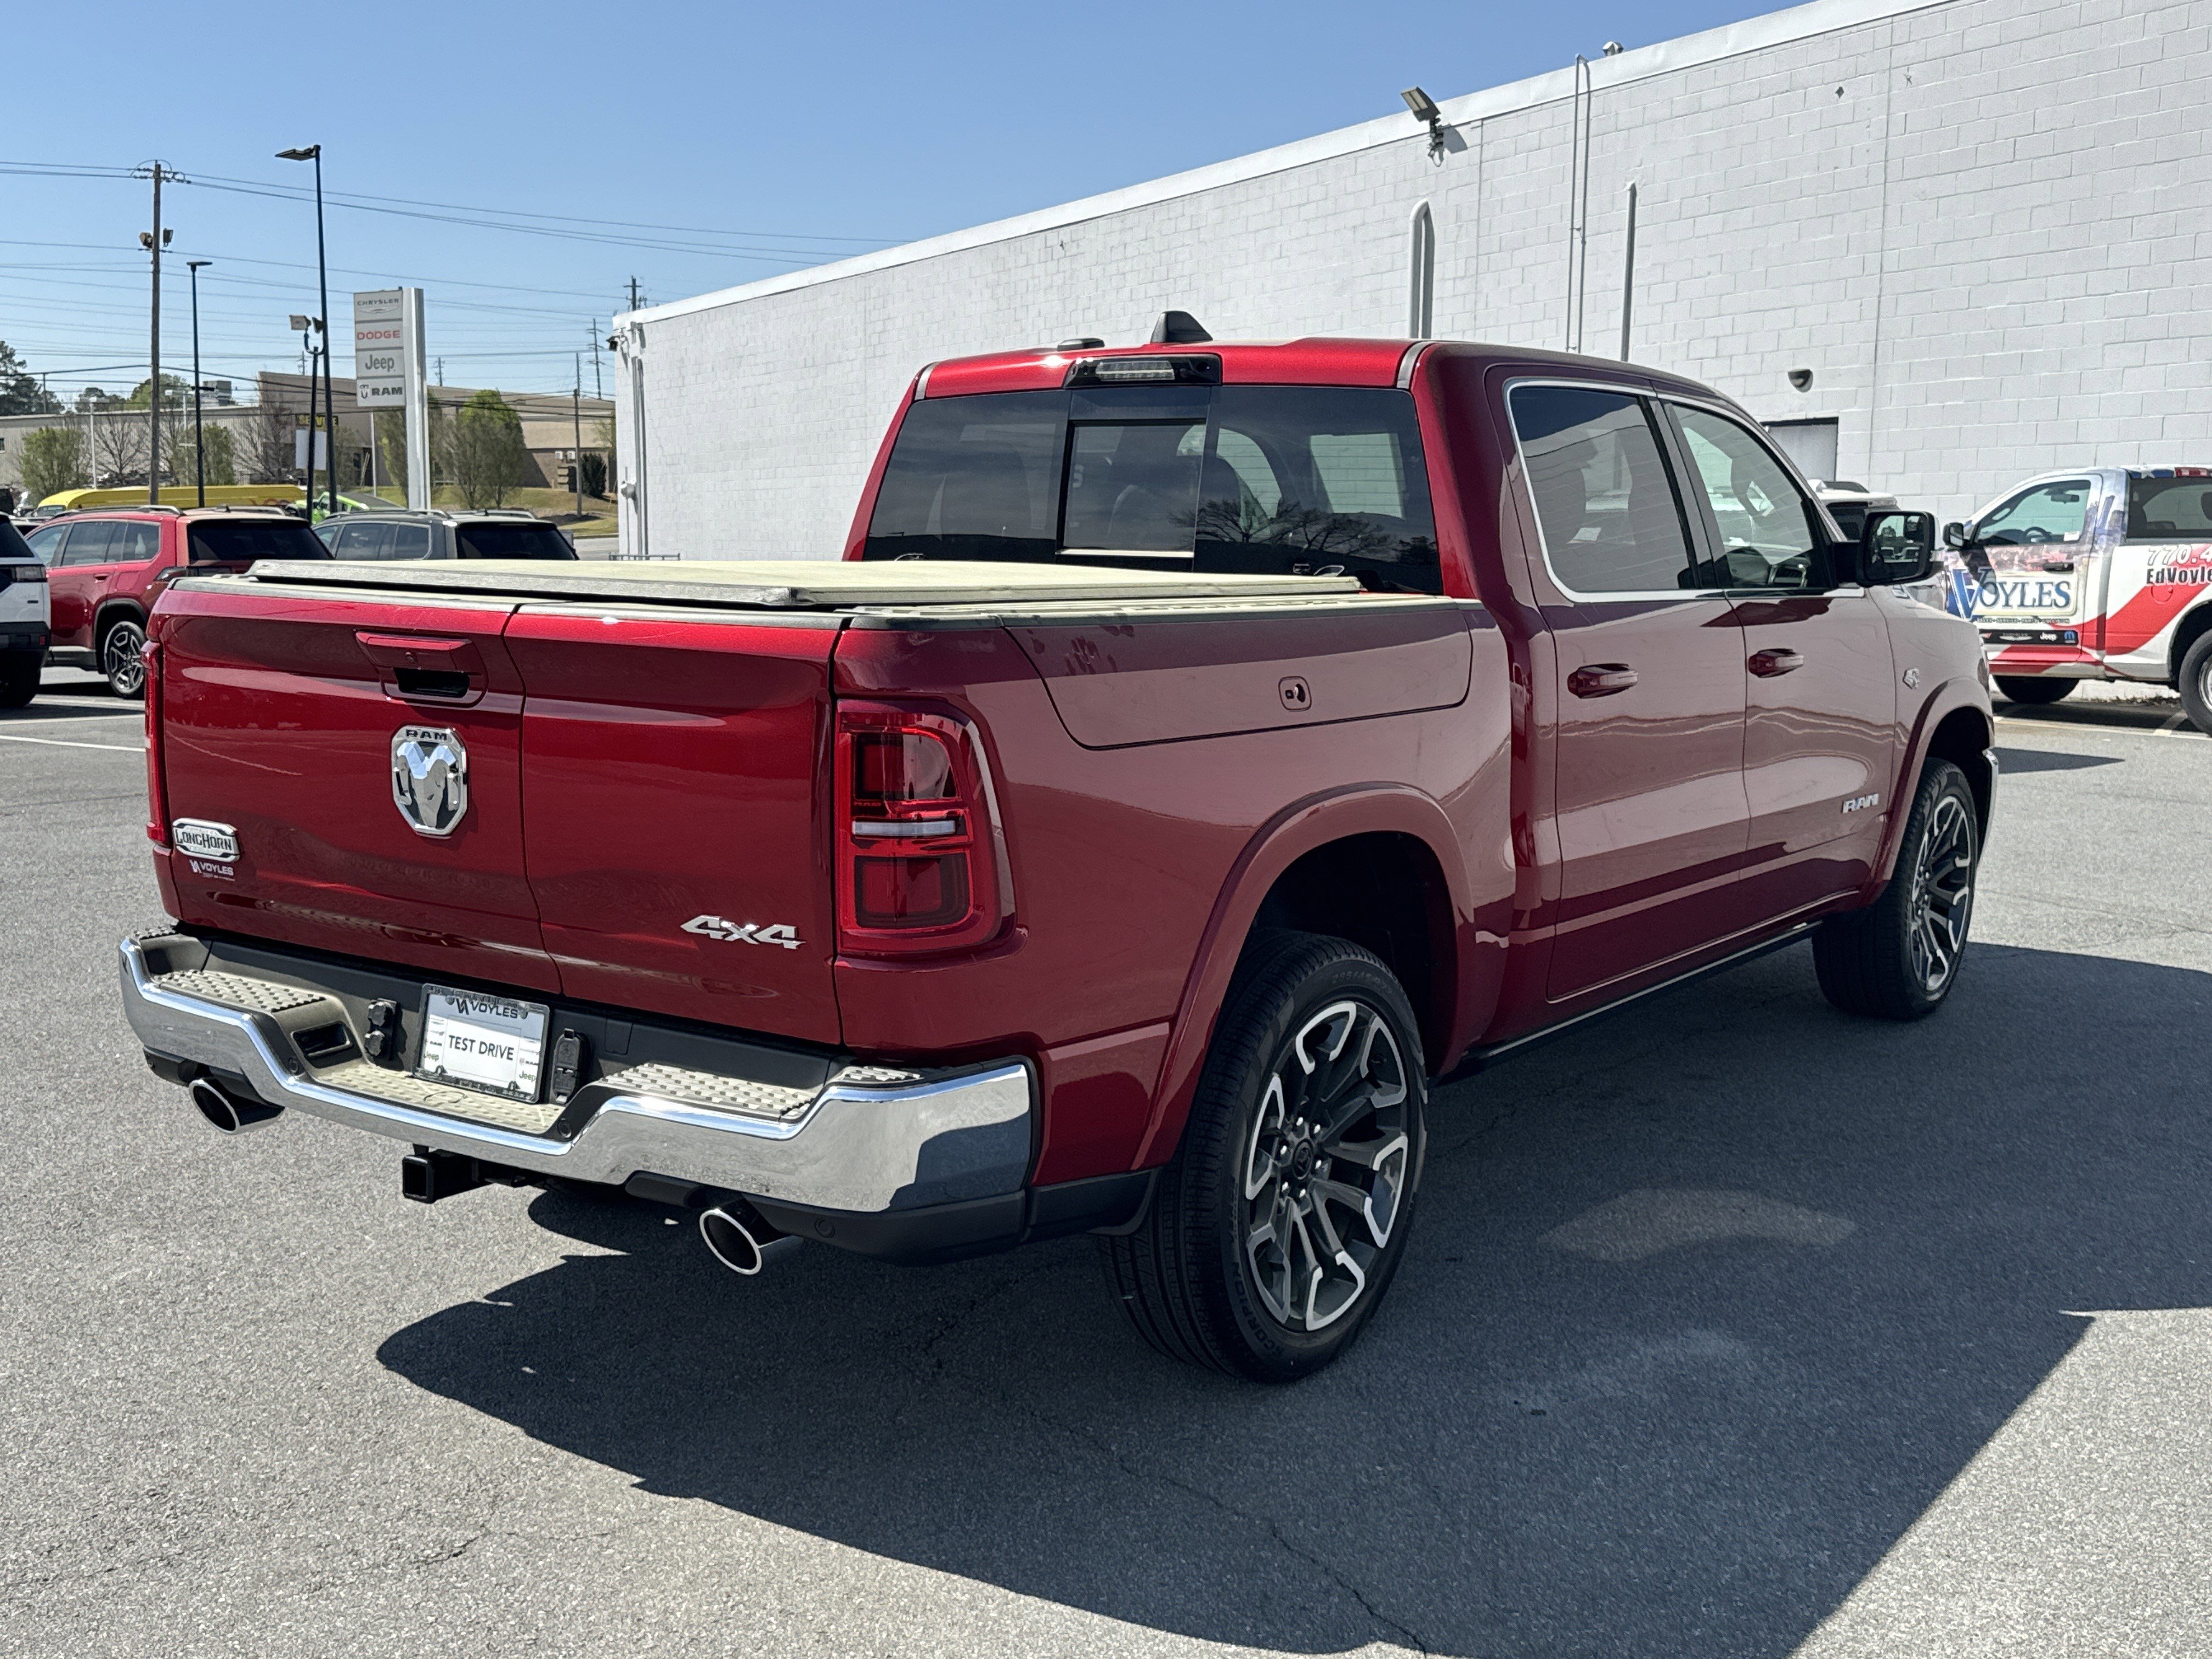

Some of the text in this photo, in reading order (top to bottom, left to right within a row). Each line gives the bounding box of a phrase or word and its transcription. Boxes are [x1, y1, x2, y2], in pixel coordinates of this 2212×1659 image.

[357, 330, 400, 340] DODGE
[365, 354, 394, 372] Jeep
[372, 387, 403, 396] RAM
[1951, 568, 2071, 619] VOYLES
[2040, 633, 2057, 641] Jeep
[406, 729, 447, 741] RAM
[1842, 794, 1879, 814] RAM
[200, 861, 234, 876] VOYLES
[470, 1001, 518, 1019] VOYLES
[448, 1034, 515, 1061] TEST DRIVE
